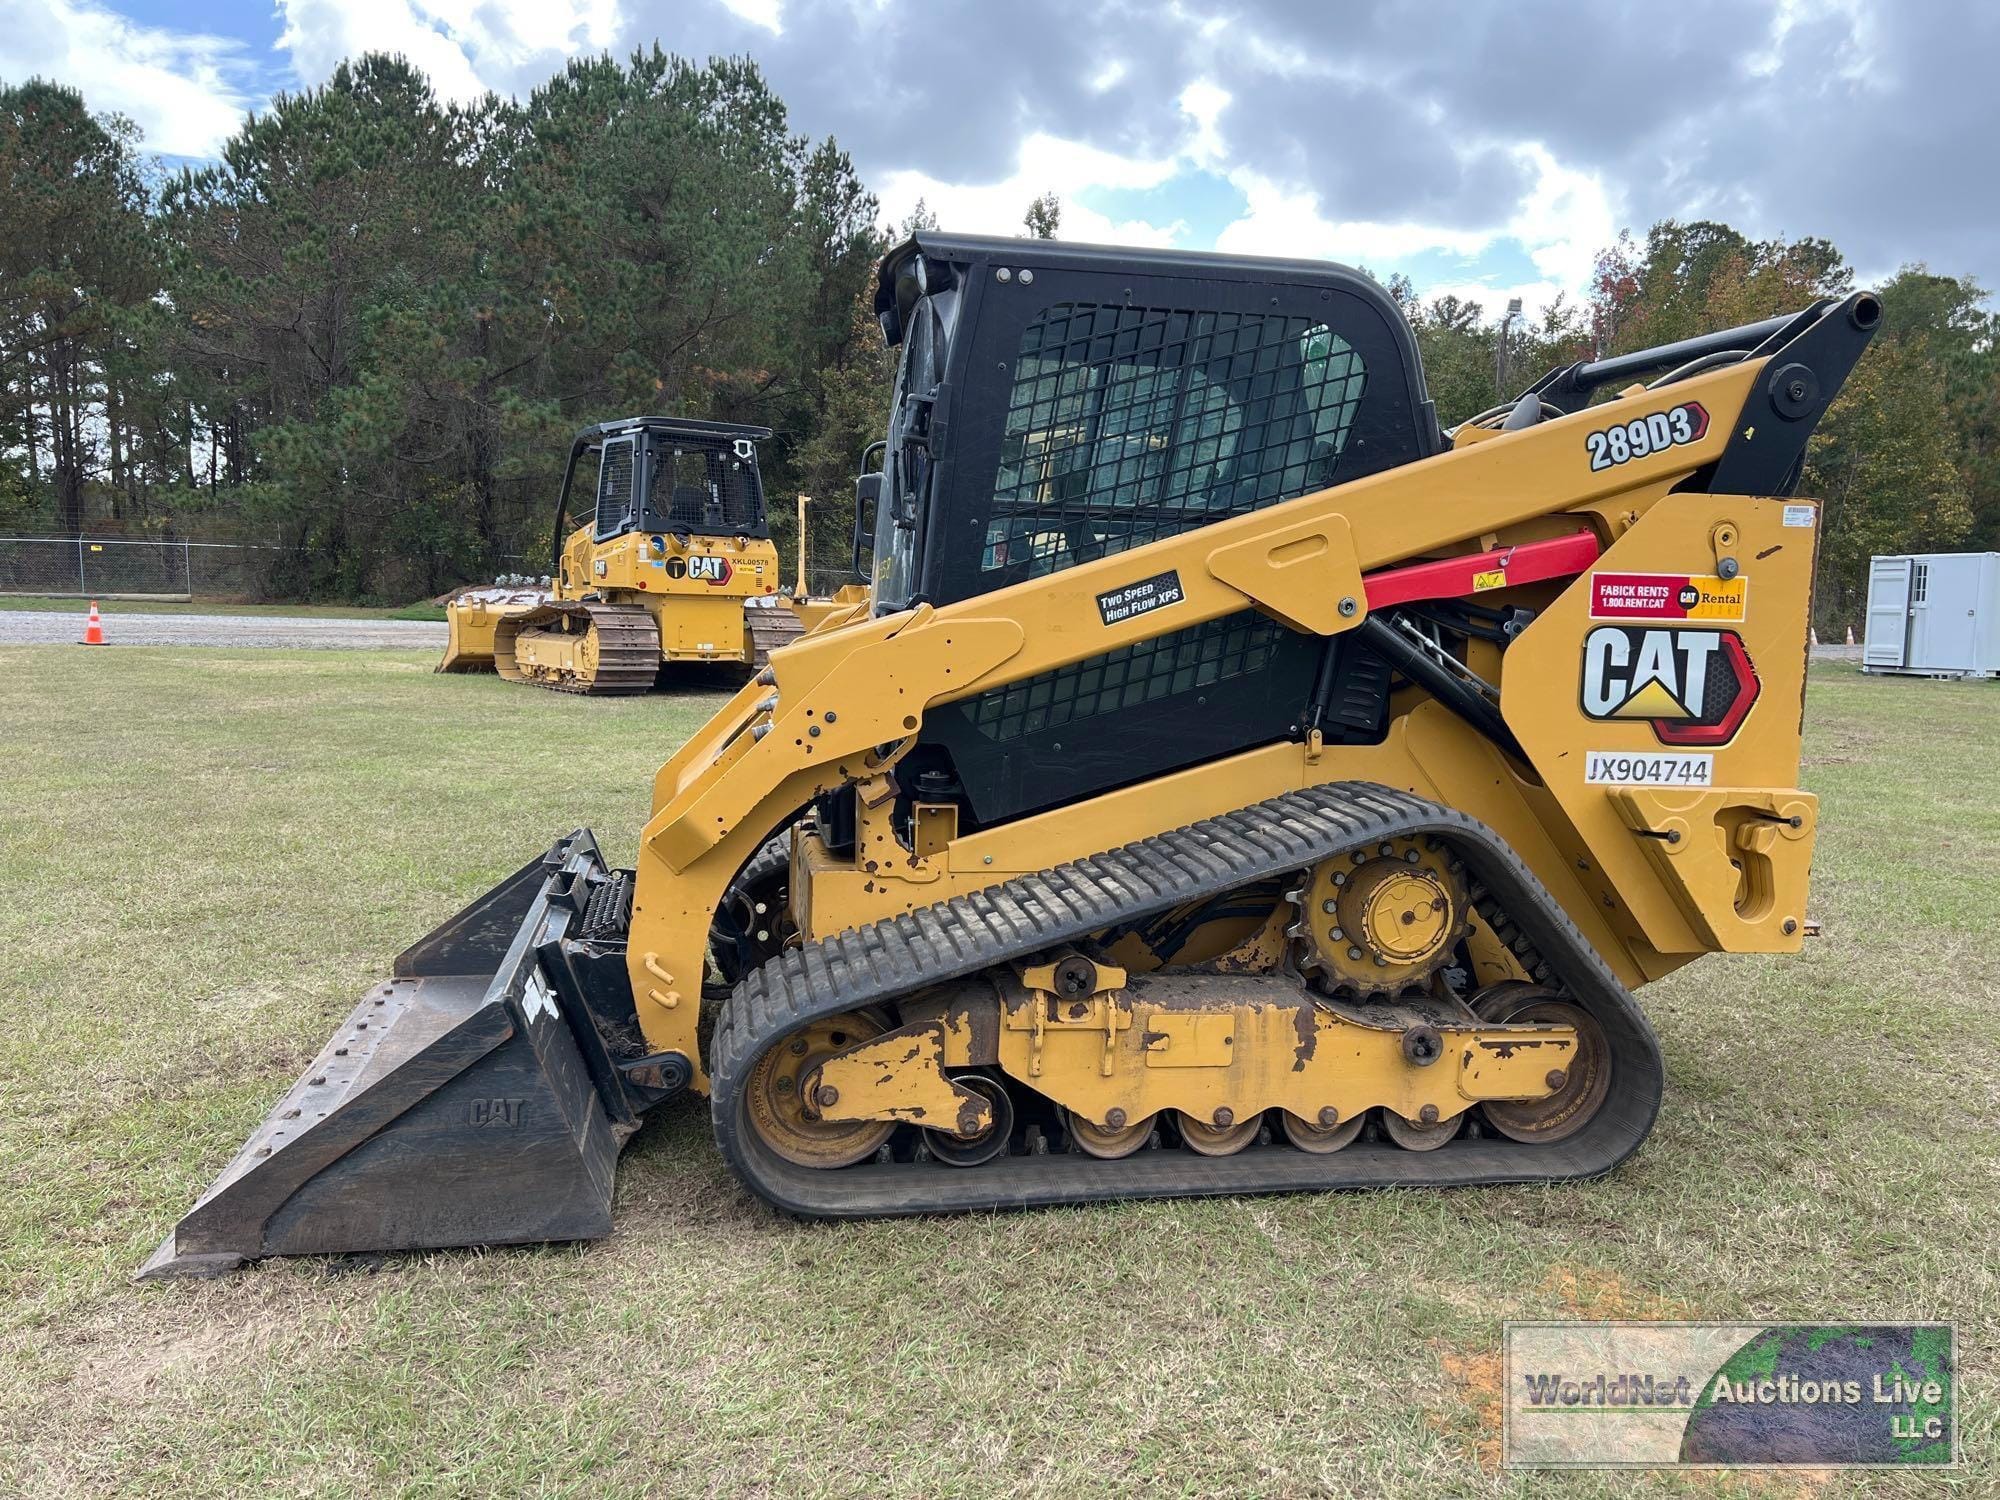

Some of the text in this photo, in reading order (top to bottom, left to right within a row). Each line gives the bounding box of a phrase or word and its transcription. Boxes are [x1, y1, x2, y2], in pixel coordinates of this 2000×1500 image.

[1587, 407, 1692, 470] 289D3
[688, 556, 722, 580] CAT
[1158, 588, 1179, 605] XPS
[1600, 585, 1669, 597] FABICK RENTS
[1602, 597, 1666, 608] 1.800.RENT.CAT
[1680, 592, 1741, 604] CAT Rental
[1583, 627, 1720, 718] CAT
[1588, 758, 1708, 783] JX904744
[469, 1098, 523, 1128] CAT
